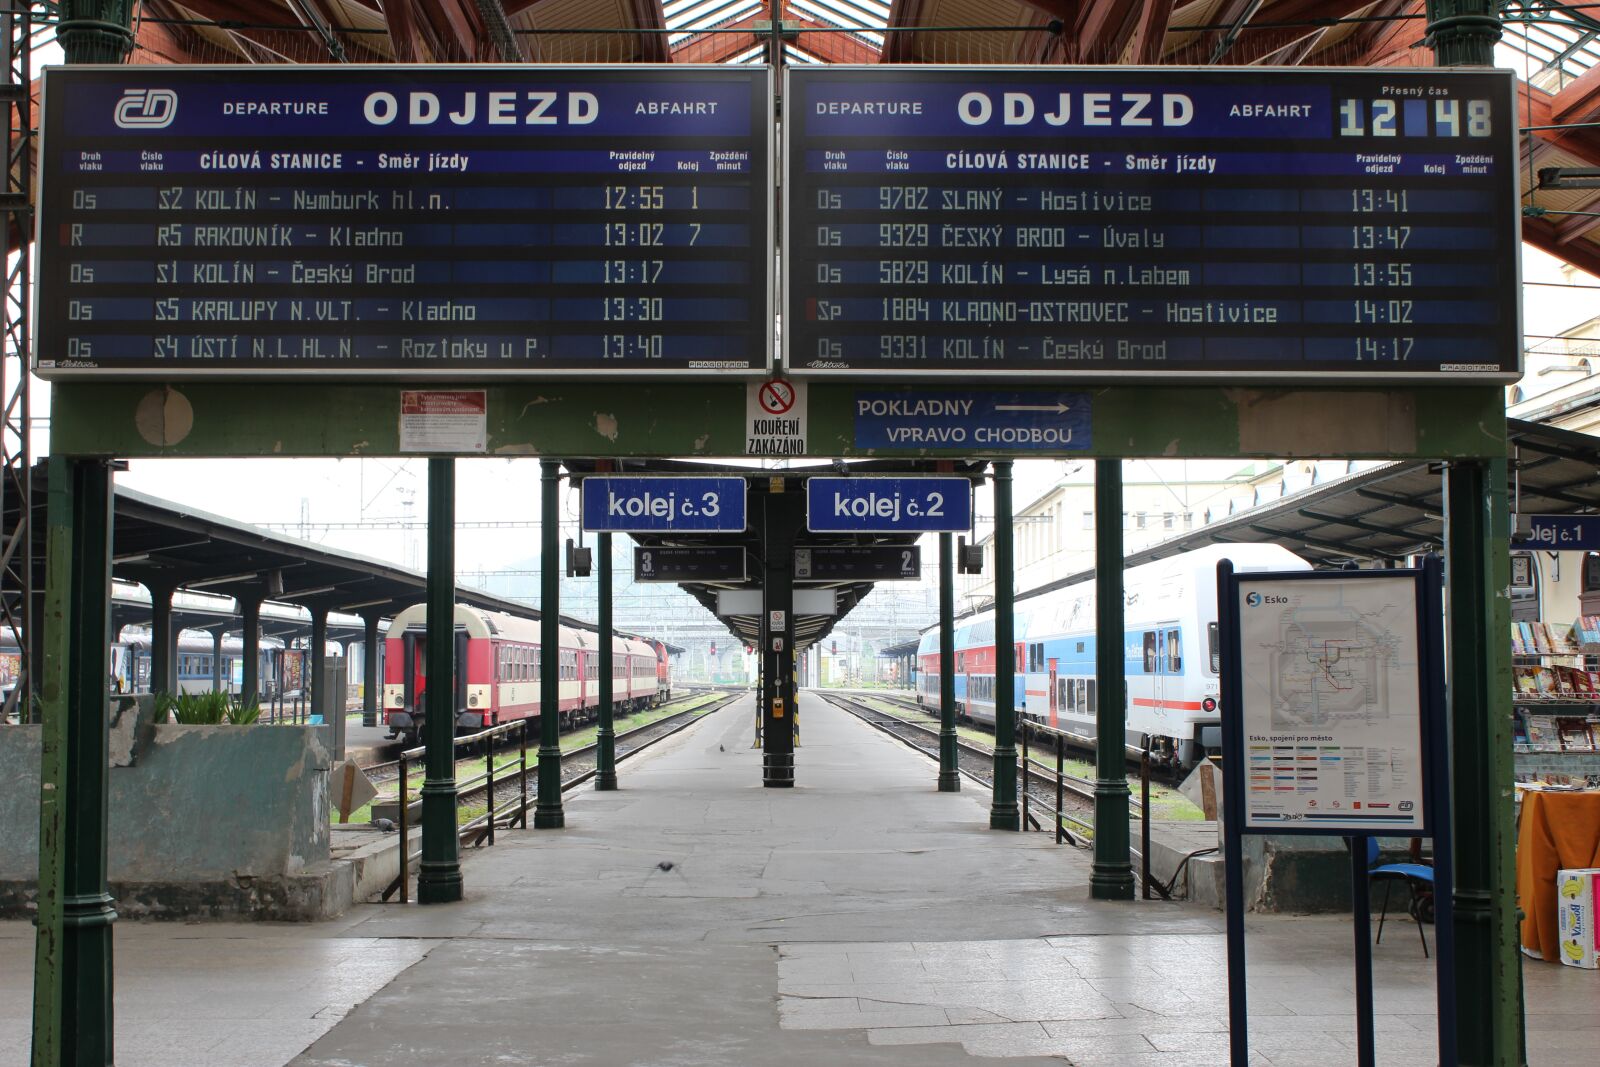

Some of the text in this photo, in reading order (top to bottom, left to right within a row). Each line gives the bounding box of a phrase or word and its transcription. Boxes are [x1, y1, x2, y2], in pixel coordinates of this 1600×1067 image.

[1382, 86, 1449, 97] Přesný čas
[223, 91, 718, 126] DEPARTURE ODJEZD ABFAHRT
[816, 91, 1312, 126] DEPARTURE ODJEZD ABFAHRT
[81, 152, 102, 161] Druh
[141, 151, 163, 161] Číslo
[200, 150, 262, 170] CÍLOVÁ
[270, 153, 343, 170] STANICE
[378, 153, 420, 170] Směr
[428, 153, 469, 172] jízdy
[609, 151, 655, 162] Pravidelný
[709, 151, 748, 162] Zpoždění
[825, 151, 846, 160] Druh
[886, 150, 908, 160] Číslo
[946, 150, 1008, 169] CÍLOVÁ
[1017, 153, 1090, 169] STANICE
[1125, 154, 1168, 171] Směr
[1176, 155, 1216, 173] jízdy
[1356, 153, 1402, 165] Pravidelný
[1455, 153, 1493, 165] Zpoždění
[79, 161, 103, 171] vlaku
[140, 161, 164, 171] vlaku
[618, 161, 647, 171] odjezd
[677, 161, 699, 172] Kolej
[716, 161, 741, 171] minut
[823, 160, 848, 170] vlaku
[885, 160, 910, 170] vlaku
[1365, 164, 1394, 174] odjezd
[1424, 164, 1446, 175] Kolej
[1462, 164, 1487, 174] minut
[73, 190, 97, 210] Os
[159, 187, 183, 210] S2
[195, 187, 256, 210] KOLÍN
[294, 190, 379, 210] Nymburk
[605, 186, 664, 210] 12:55
[691, 186, 699, 210] 1
[817, 189, 842, 210] Os
[880, 187, 929, 210] 9782
[942, 187, 1003, 210] SLANÝ
[1041, 191, 1152, 212] Hostivice
[1352, 189, 1409, 213] 13:41
[71, 224, 83, 247] R
[158, 224, 182, 247] R5
[194, 223, 292, 247] RAKOVNÍK
[330, 227, 403, 247] Kladno
[604, 223, 664, 247] 13:02
[689, 223, 701, 247] 7
[817, 226, 842, 247] Os
[880, 223, 929, 247] 9329
[942, 224, 1003, 248] ČESKÝ
[1103, 224, 1164, 248] Úvaly
[1352, 226, 1411, 249] 13:47
[70, 263, 94, 284] Os
[157, 261, 178, 284] S1
[194, 261, 254, 284] KOLÍN
[291, 261, 352, 284] Český
[366, 264, 415, 284] Brod
[604, 260, 663, 284] 13:17
[817, 263, 841, 284] Os
[880, 260, 929, 284] 5829
[942, 261, 1003, 285] KOLÍN
[1042, 264, 1090, 285] Lysá
[1354, 263, 1412, 287] 13:55
[69, 300, 93, 321] Os
[155, 298, 179, 321] S5
[192, 300, 277, 321] KRALUPY
[402, 301, 476, 322] Kladno
[603, 298, 663, 321] 13:30
[817, 300, 842, 321] Sp
[882, 298, 929, 321] 1884
[1167, 303, 1277, 323] Hostivice
[1355, 300, 1413, 324] 14:02
[68, 338, 92, 358] Os
[154, 338, 179, 358] S4
[191, 335, 238, 358] ÚSTÍ
[401, 338, 488, 359] Roztoky
[500, 342, 512, 359] u
[526, 338, 547, 359] P.
[603, 335, 663, 359] 13:40
[818, 338, 842, 359] Os
[880, 335, 928, 359] 9331
[943, 336, 1004, 360] KOLÍN
[1043, 336, 1104, 360] Český
[1117, 338, 1166, 360] Brod
[1355, 338, 1414, 361] 14:17
[857, 399, 974, 416] POKLADNY
[753, 416, 800, 436] KOUŘENÍ
[886, 427, 1073, 443] VPRAVO CHODBOU
[748, 438, 804, 455] ZAKÁZÁNO
[608, 491, 720, 520] kolej č.3
[834, 491, 944, 520] kolej č.2
[1526, 524, 1557, 544] olej
[1264, 595, 1288, 604] Esko
